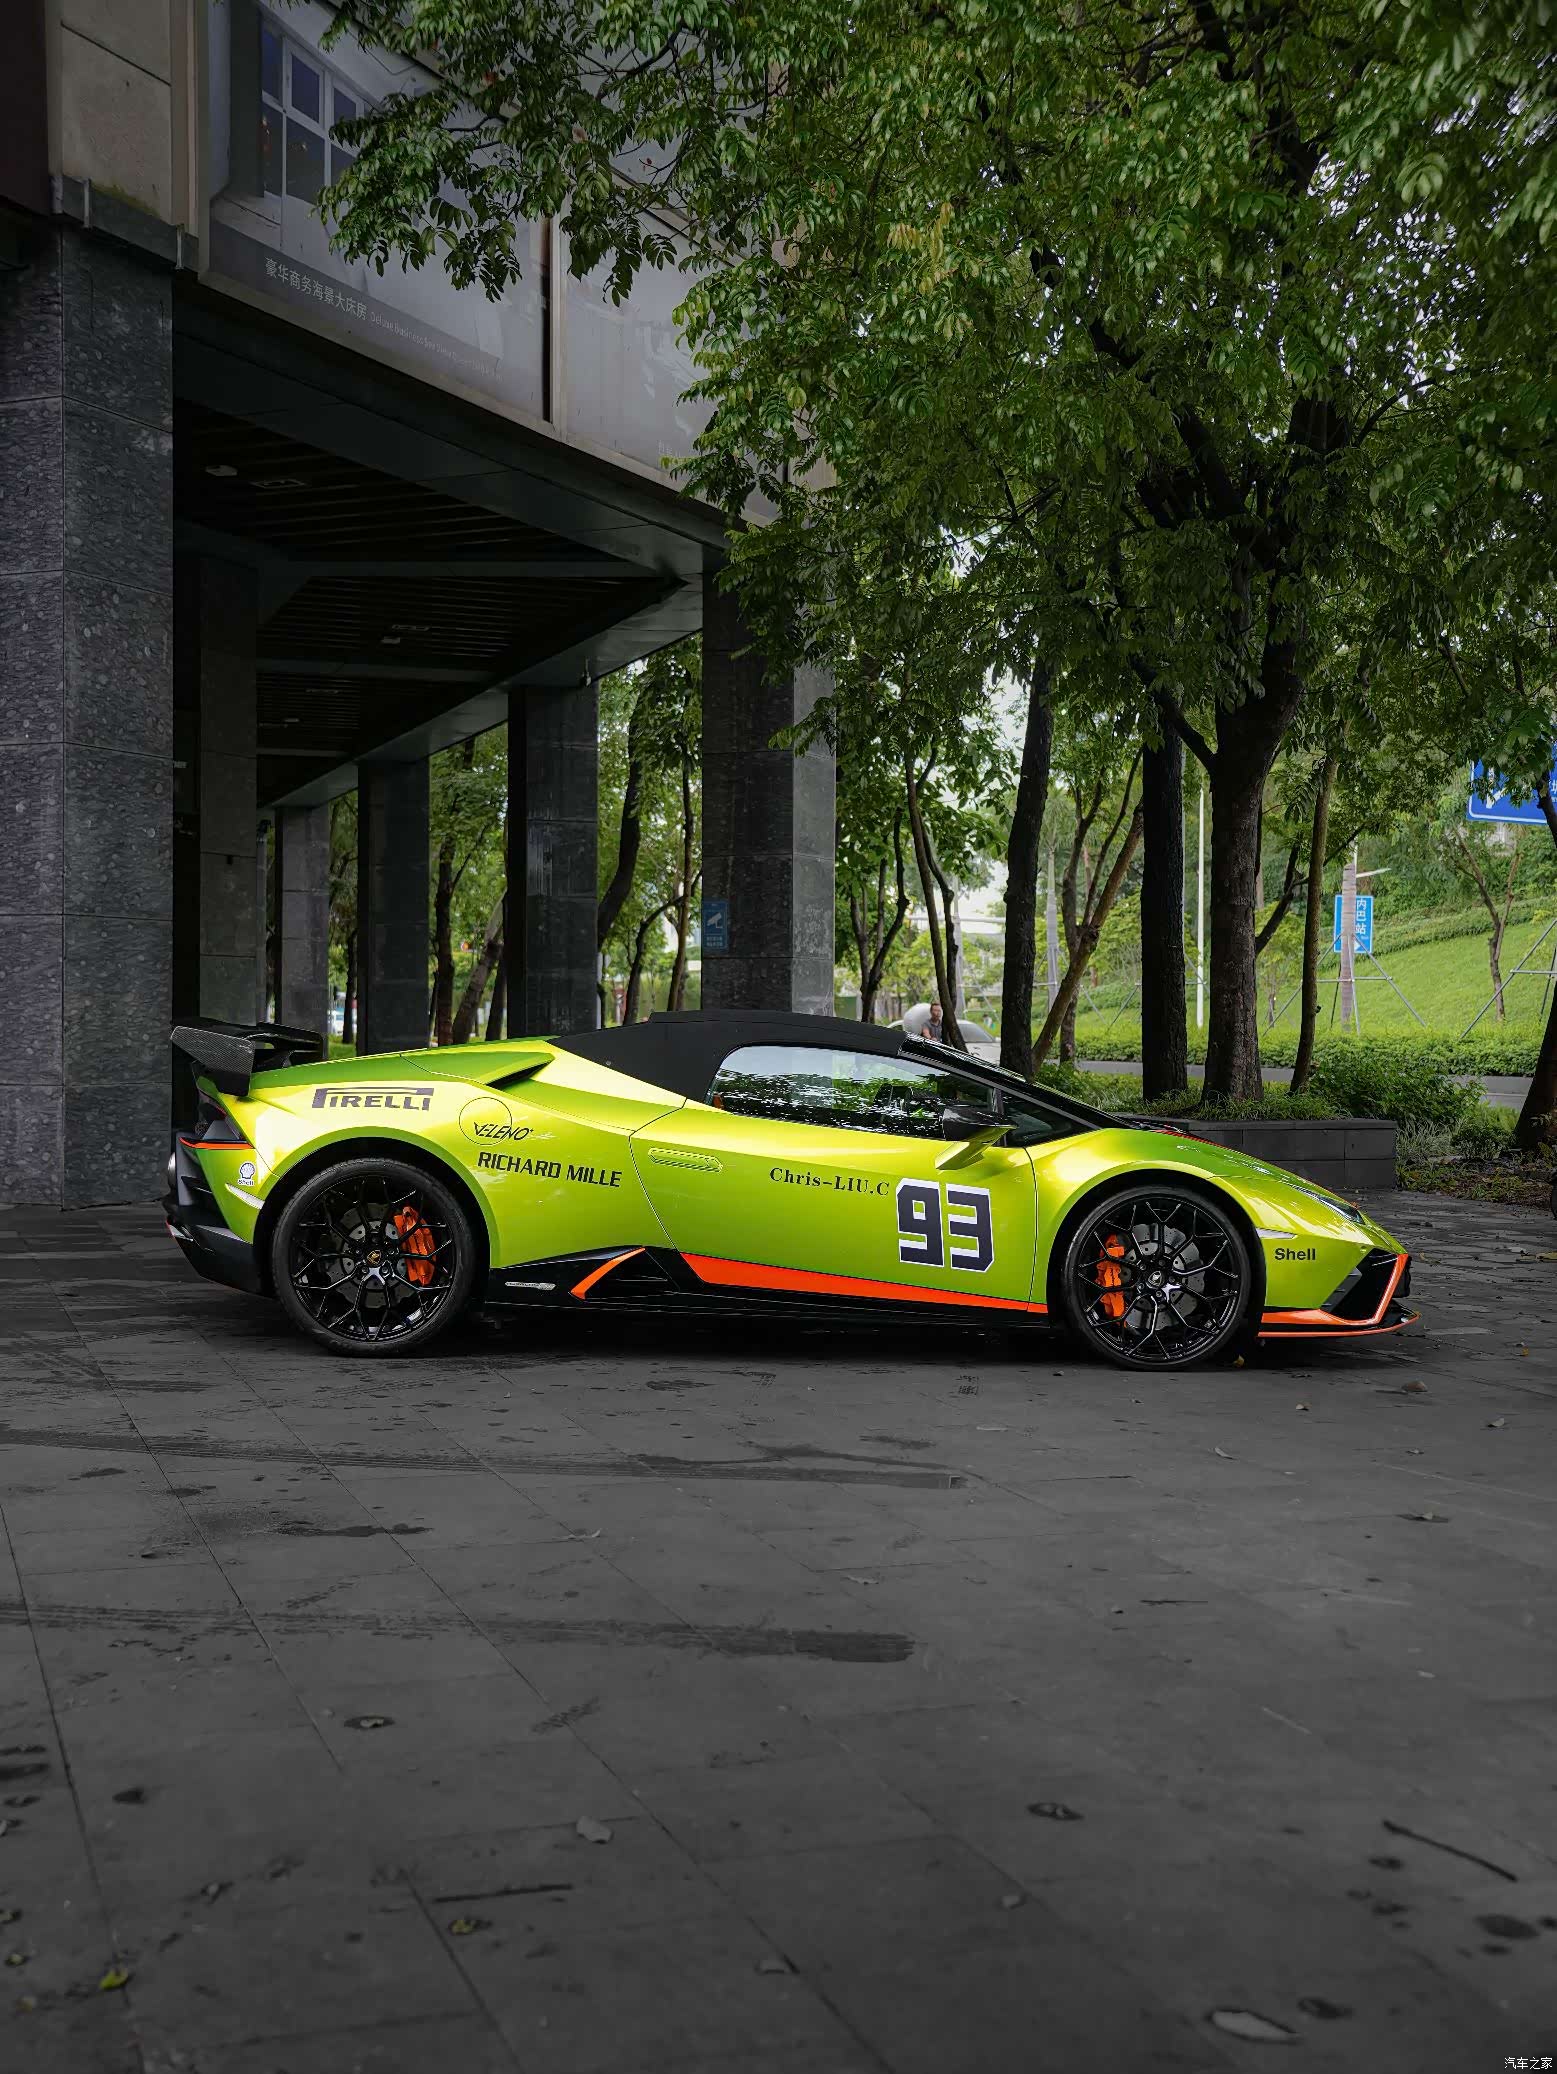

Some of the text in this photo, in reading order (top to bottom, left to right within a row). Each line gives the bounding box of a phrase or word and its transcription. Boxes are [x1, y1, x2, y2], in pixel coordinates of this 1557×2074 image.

[311, 1086, 434, 1111] PIRELLI
[478, 1152, 623, 1188] RICHARD MILLE
[769, 1167, 890, 1197] Chris-LIU.C
[896, 1177, 995, 1273] 93
[1274, 1247, 1316, 1261] Shell
